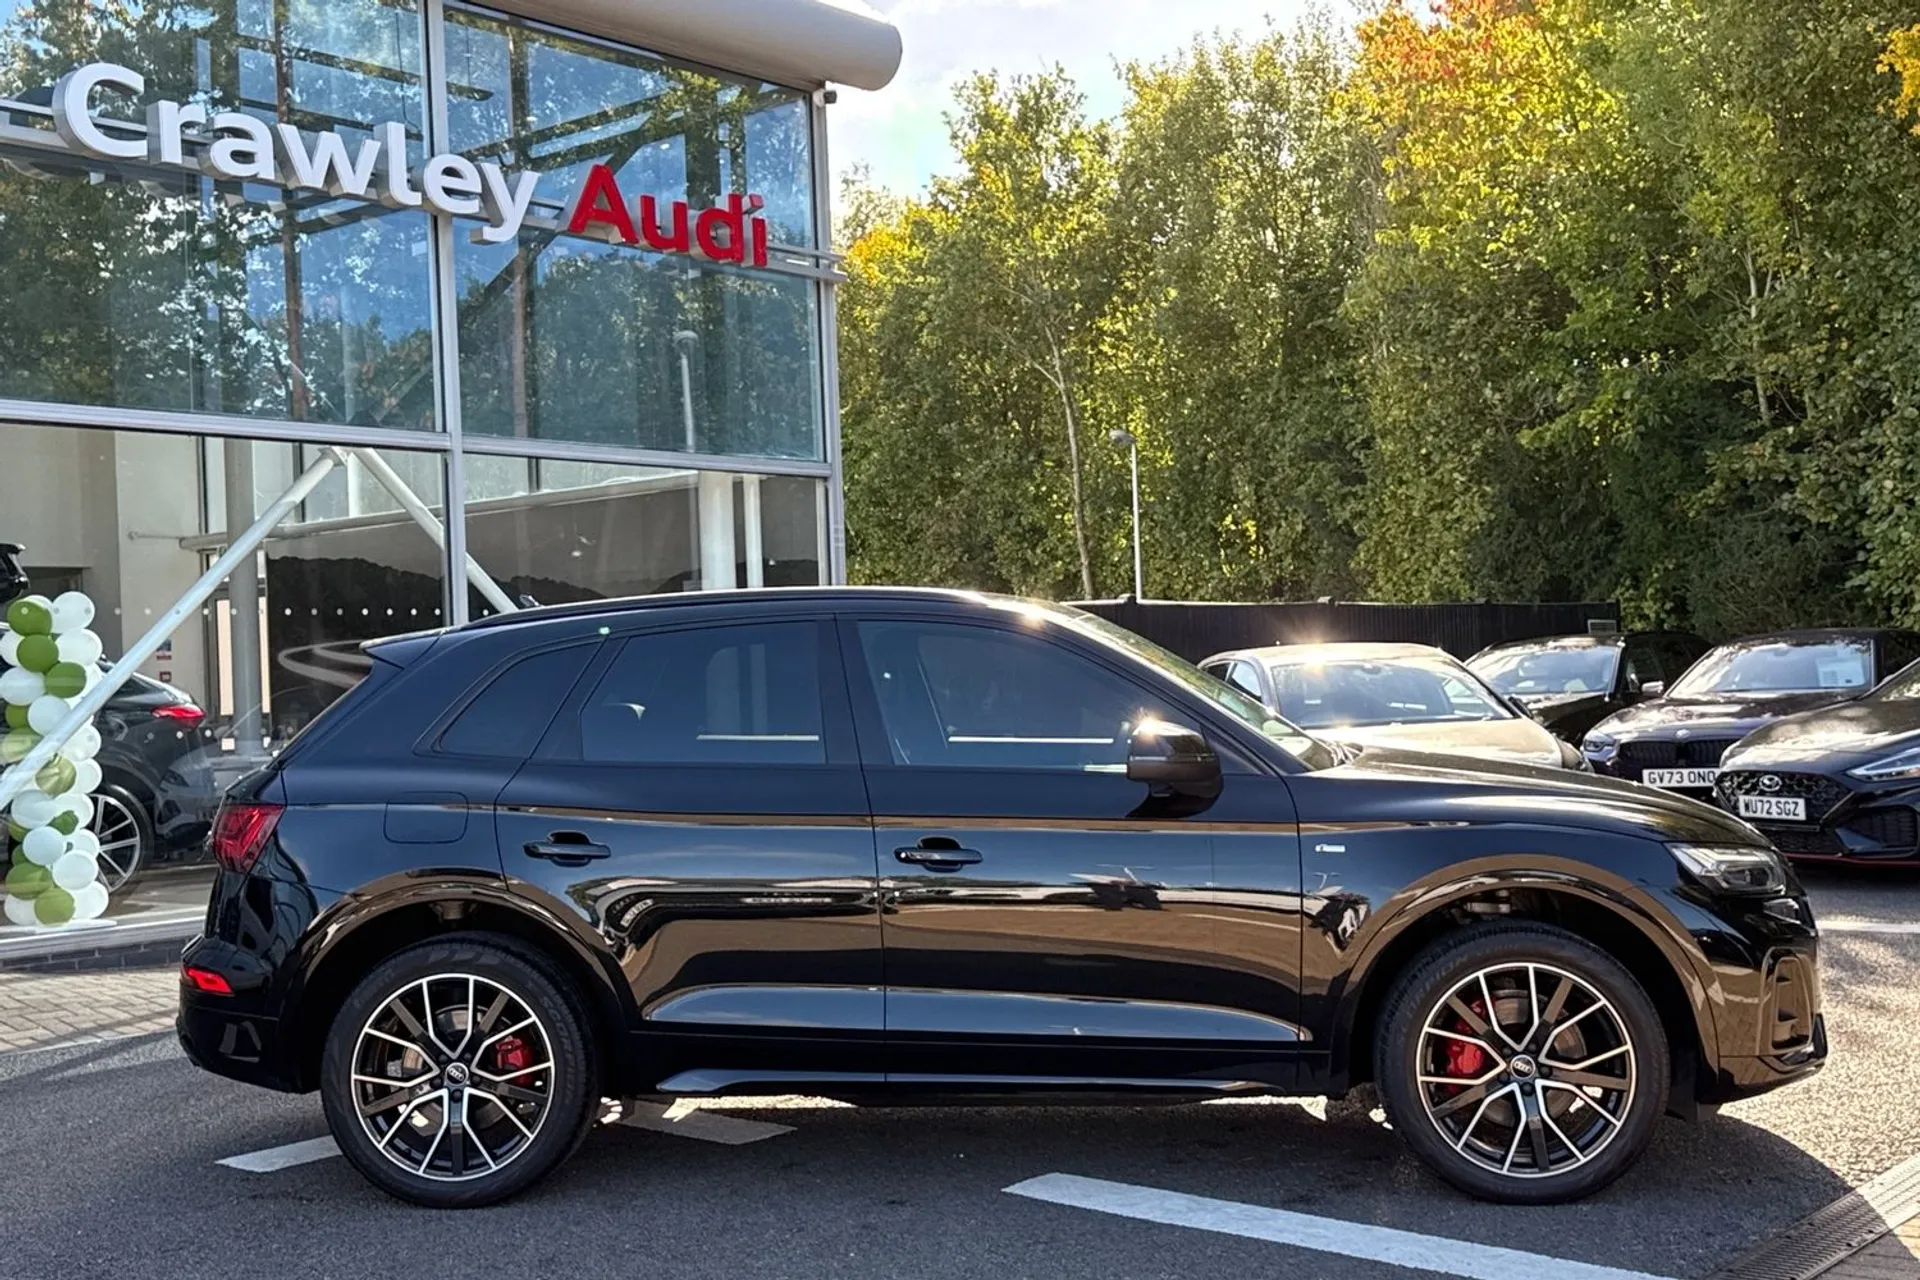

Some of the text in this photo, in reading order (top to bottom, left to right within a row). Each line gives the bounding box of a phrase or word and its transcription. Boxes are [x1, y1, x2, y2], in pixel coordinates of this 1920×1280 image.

[52, 62, 767, 268] Crawley Audi
[1648, 771, 1684, 784] GV73
[1775, 800, 1800, 817] SGZ
